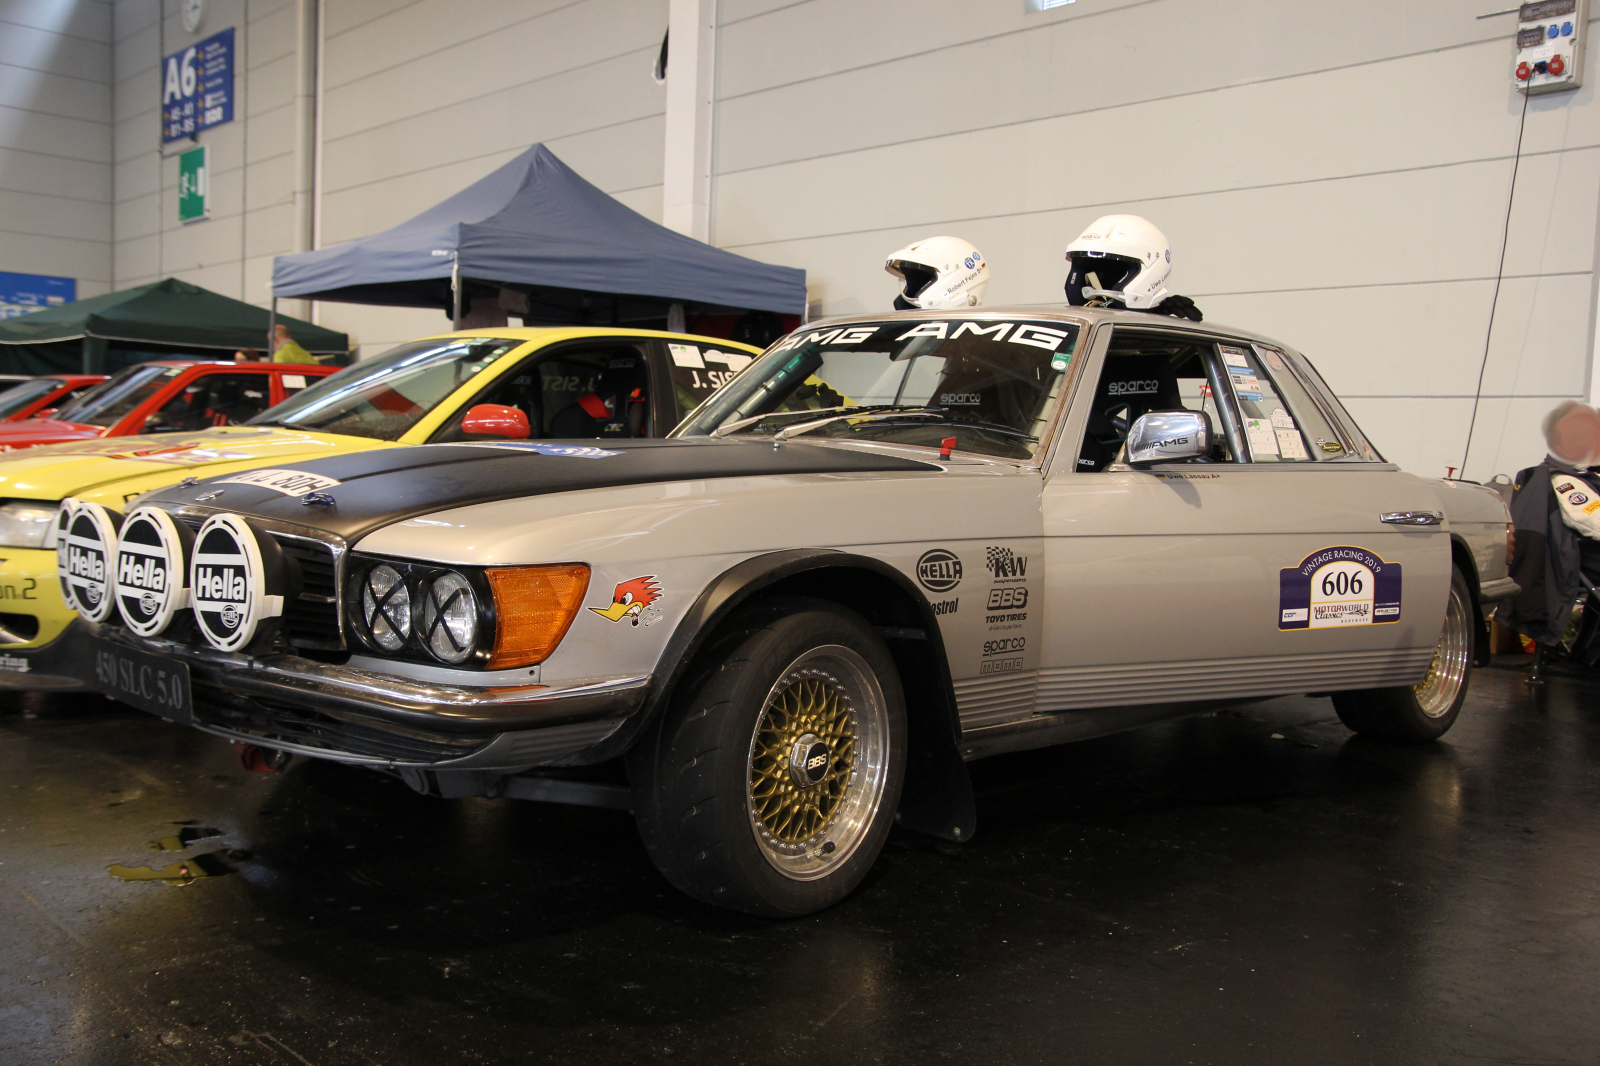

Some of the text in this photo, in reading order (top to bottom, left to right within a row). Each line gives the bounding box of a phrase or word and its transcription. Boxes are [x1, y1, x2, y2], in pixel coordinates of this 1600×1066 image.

[163, 46, 197, 105] A6
[947, 279, 966, 294] Robert
[1150, 278, 1161, 290] Uwe
[772, 326, 881, 353] AMG
[894, 322, 1069, 351] AMG
[692, 370, 738, 389] J. SIS
[1108, 379, 1159, 395] sparco
[940, 393, 981, 405] sparco
[1151, 437, 1189, 449] AMG
[69, 546, 104, 581] Hella
[118, 554, 166, 591] Hella
[920, 560, 962, 580] HELLA
[994, 556, 1028, 578] KW
[1302, 549, 1382, 576] VINTAGE RACING 2019
[196, 567, 246, 601] Hella
[1321, 570, 1363, 596] 606
[929, 597, 959, 616] astrol
[987, 587, 1029, 611] BBS
[1313, 603, 1369, 614] MOTORWORLD
[986, 613, 1027, 624] TOYO TIRES
[1314, 611, 1344, 620] Classics
[982, 636, 1026, 657] sparco
[980, 656, 1024, 675] momo
[96, 649, 183, 710] 450 SLC 5.0
[807, 753, 827, 770] BBS
